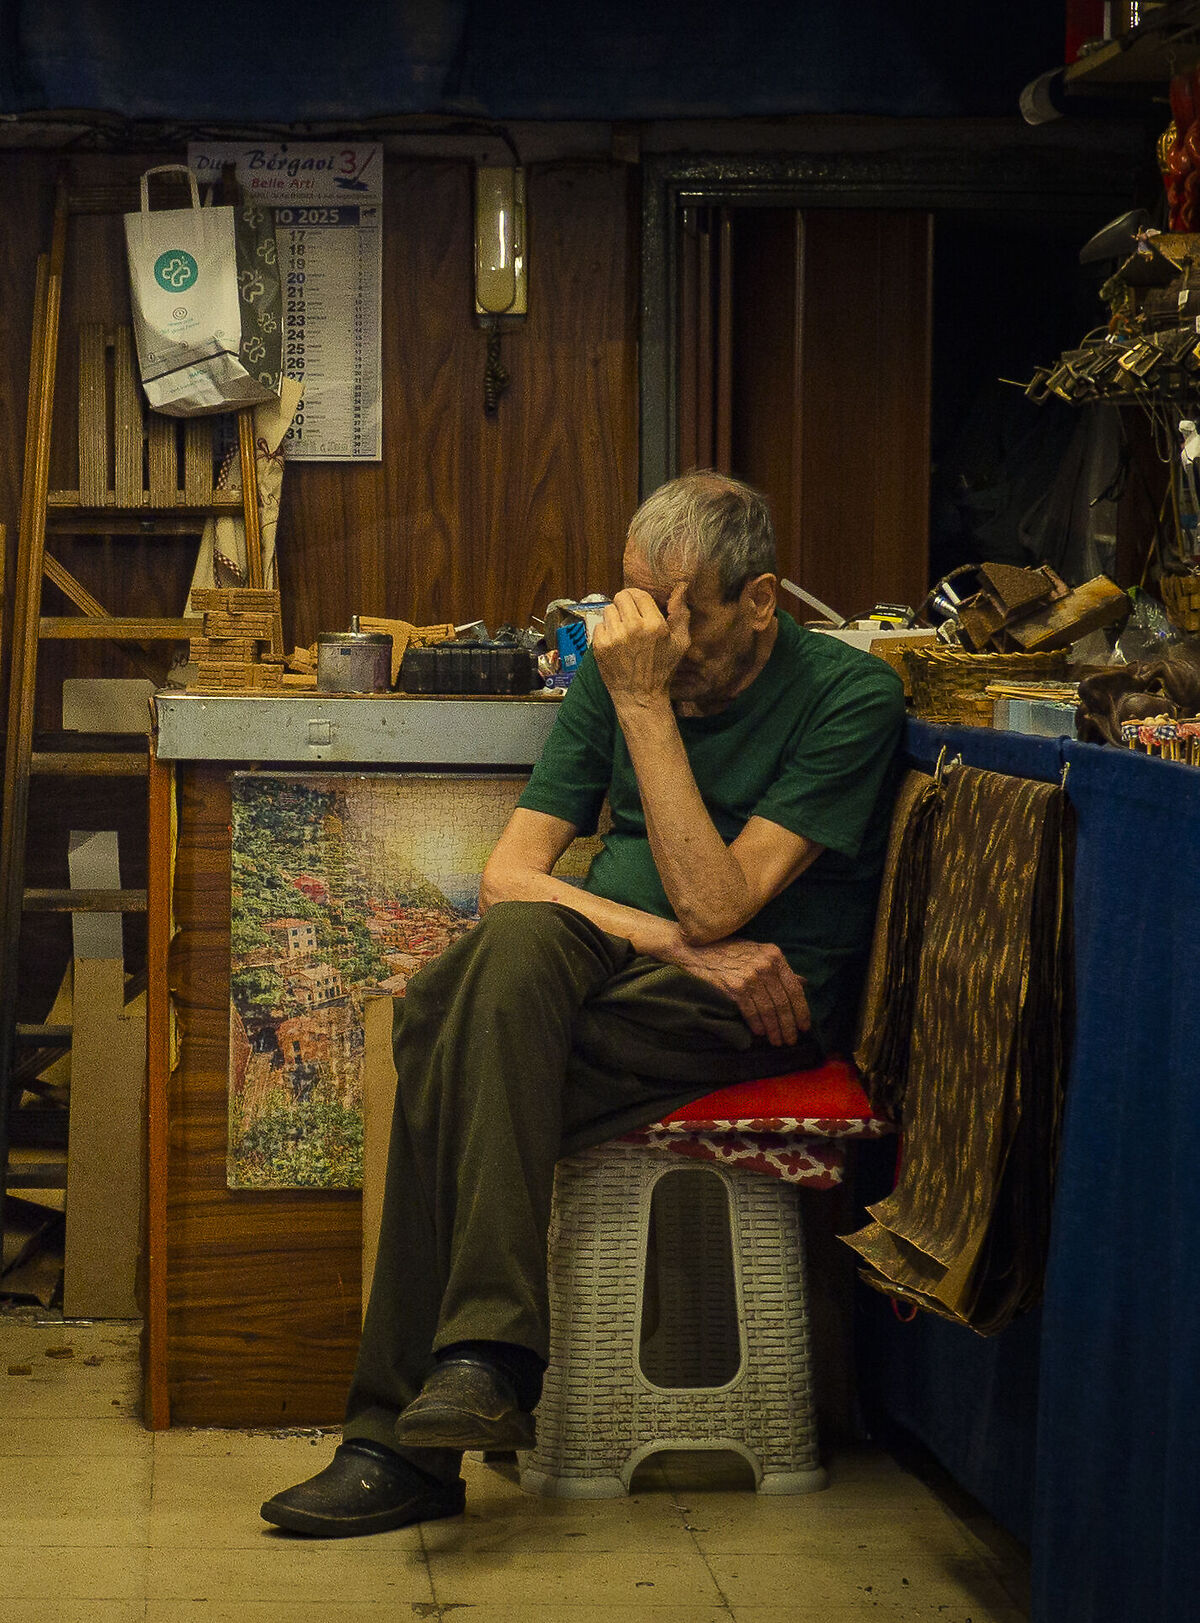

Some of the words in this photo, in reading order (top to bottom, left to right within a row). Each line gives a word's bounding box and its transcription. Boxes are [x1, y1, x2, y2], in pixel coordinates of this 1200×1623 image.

[339, 150, 357, 174] 3
[251, 177, 285, 189] Belle
[291, 177, 315, 189] Arti
[297, 209, 340, 224] 2025
[287, 272, 306, 284] 20
[287, 286, 304, 298] 21
[287, 300, 306, 312] 22
[287, 314, 306, 326] 23
[287, 329, 305, 340] 24
[287, 344, 305, 355] 25
[287, 358, 305, 369] 26
[292, 414, 304, 425] 0
[285, 428, 302, 440] 31
